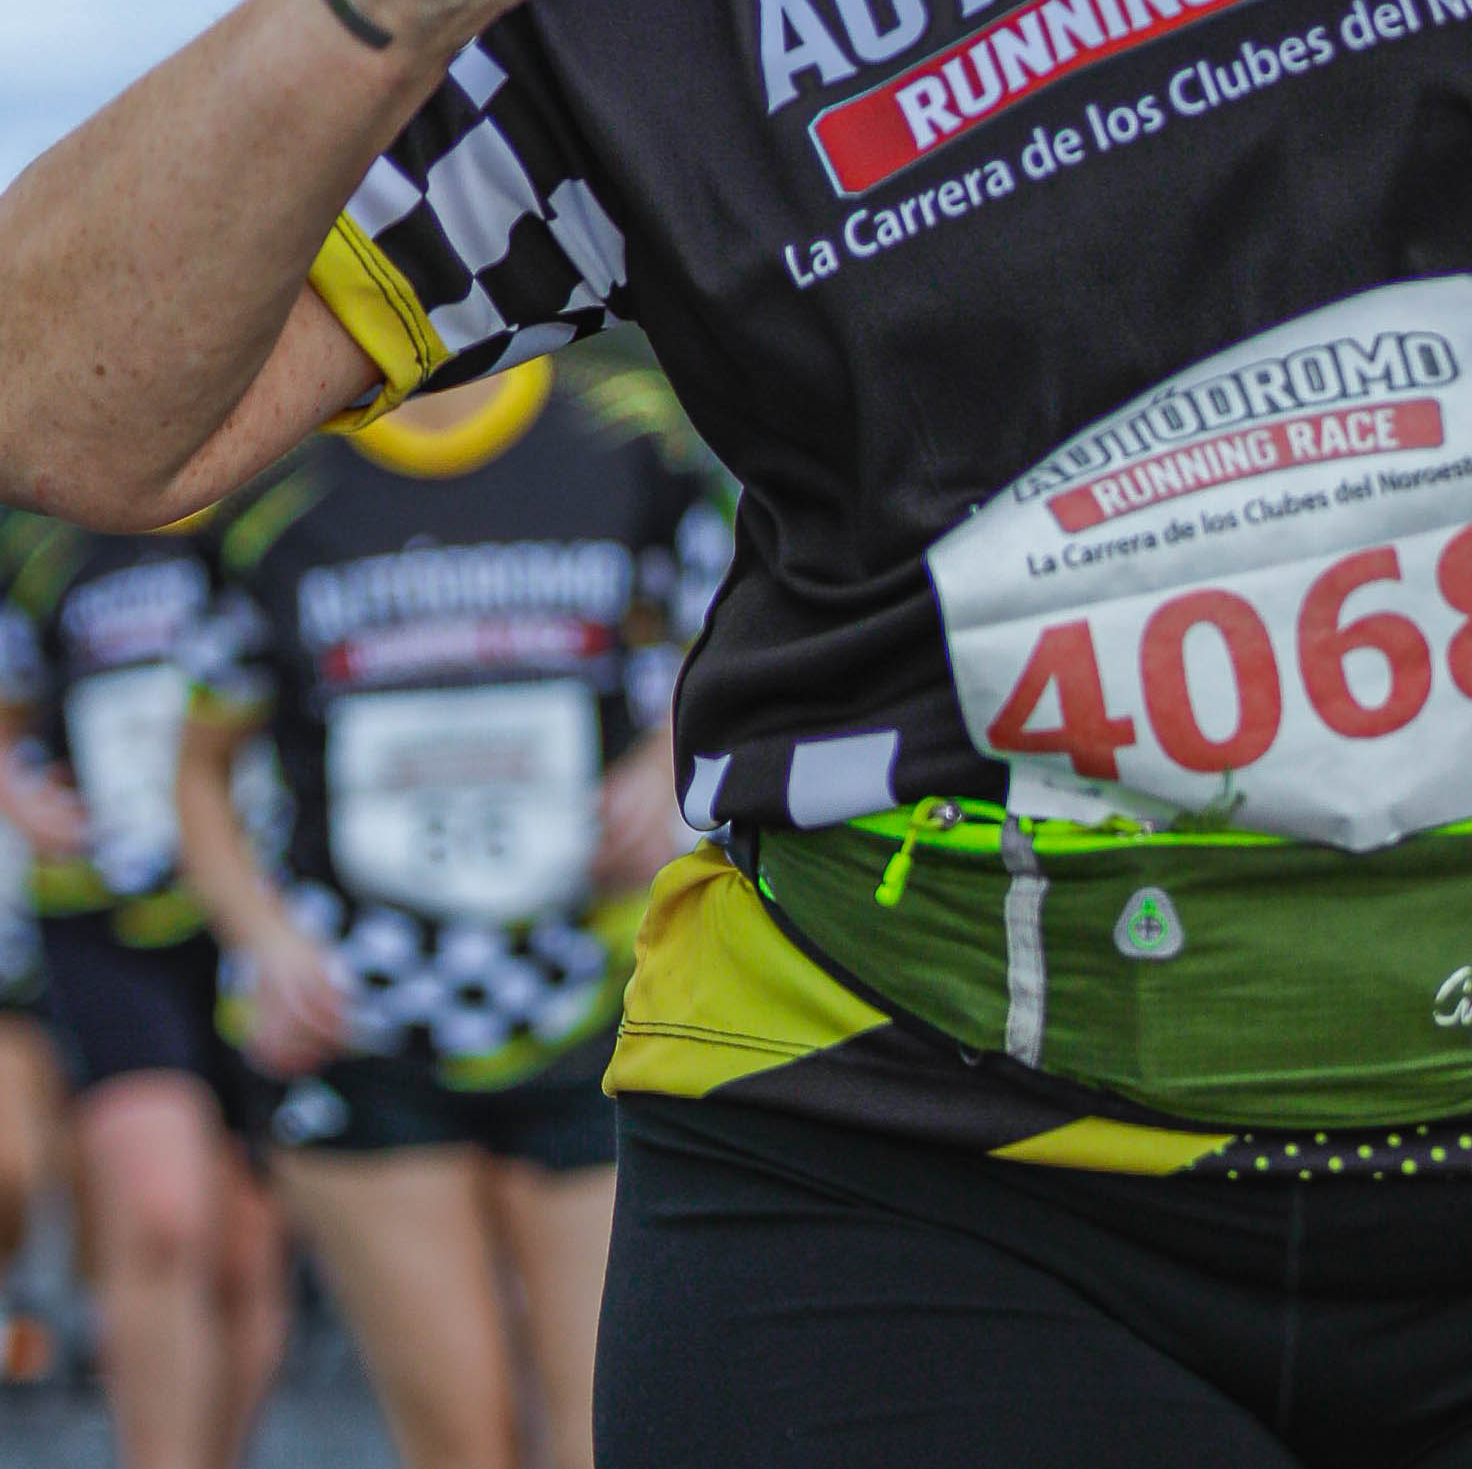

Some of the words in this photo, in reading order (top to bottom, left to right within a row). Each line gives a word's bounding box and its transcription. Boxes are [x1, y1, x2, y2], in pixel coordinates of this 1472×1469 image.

[784, 238, 839, 289] La
[843, 158, 1015, 257] Carrera
[1021, 128, 1086, 180] de
[1086, 94, 1165, 151] los
[1169, 26, 1333, 116] Clubes
[1012, 331, 1460, 503] AUTÓDROMO
[1090, 429, 1277, 517] RUNNING
[1286, 408, 1400, 461] RACE
[1027, 552, 1056, 576] La
[1062, 532, 1156, 567] Carrera
[1164, 519, 1195, 543] de
[1201, 510, 1238, 534] los
[1243, 490, 1328, 524] Clubes
[1334, 474, 1372, 504] del
